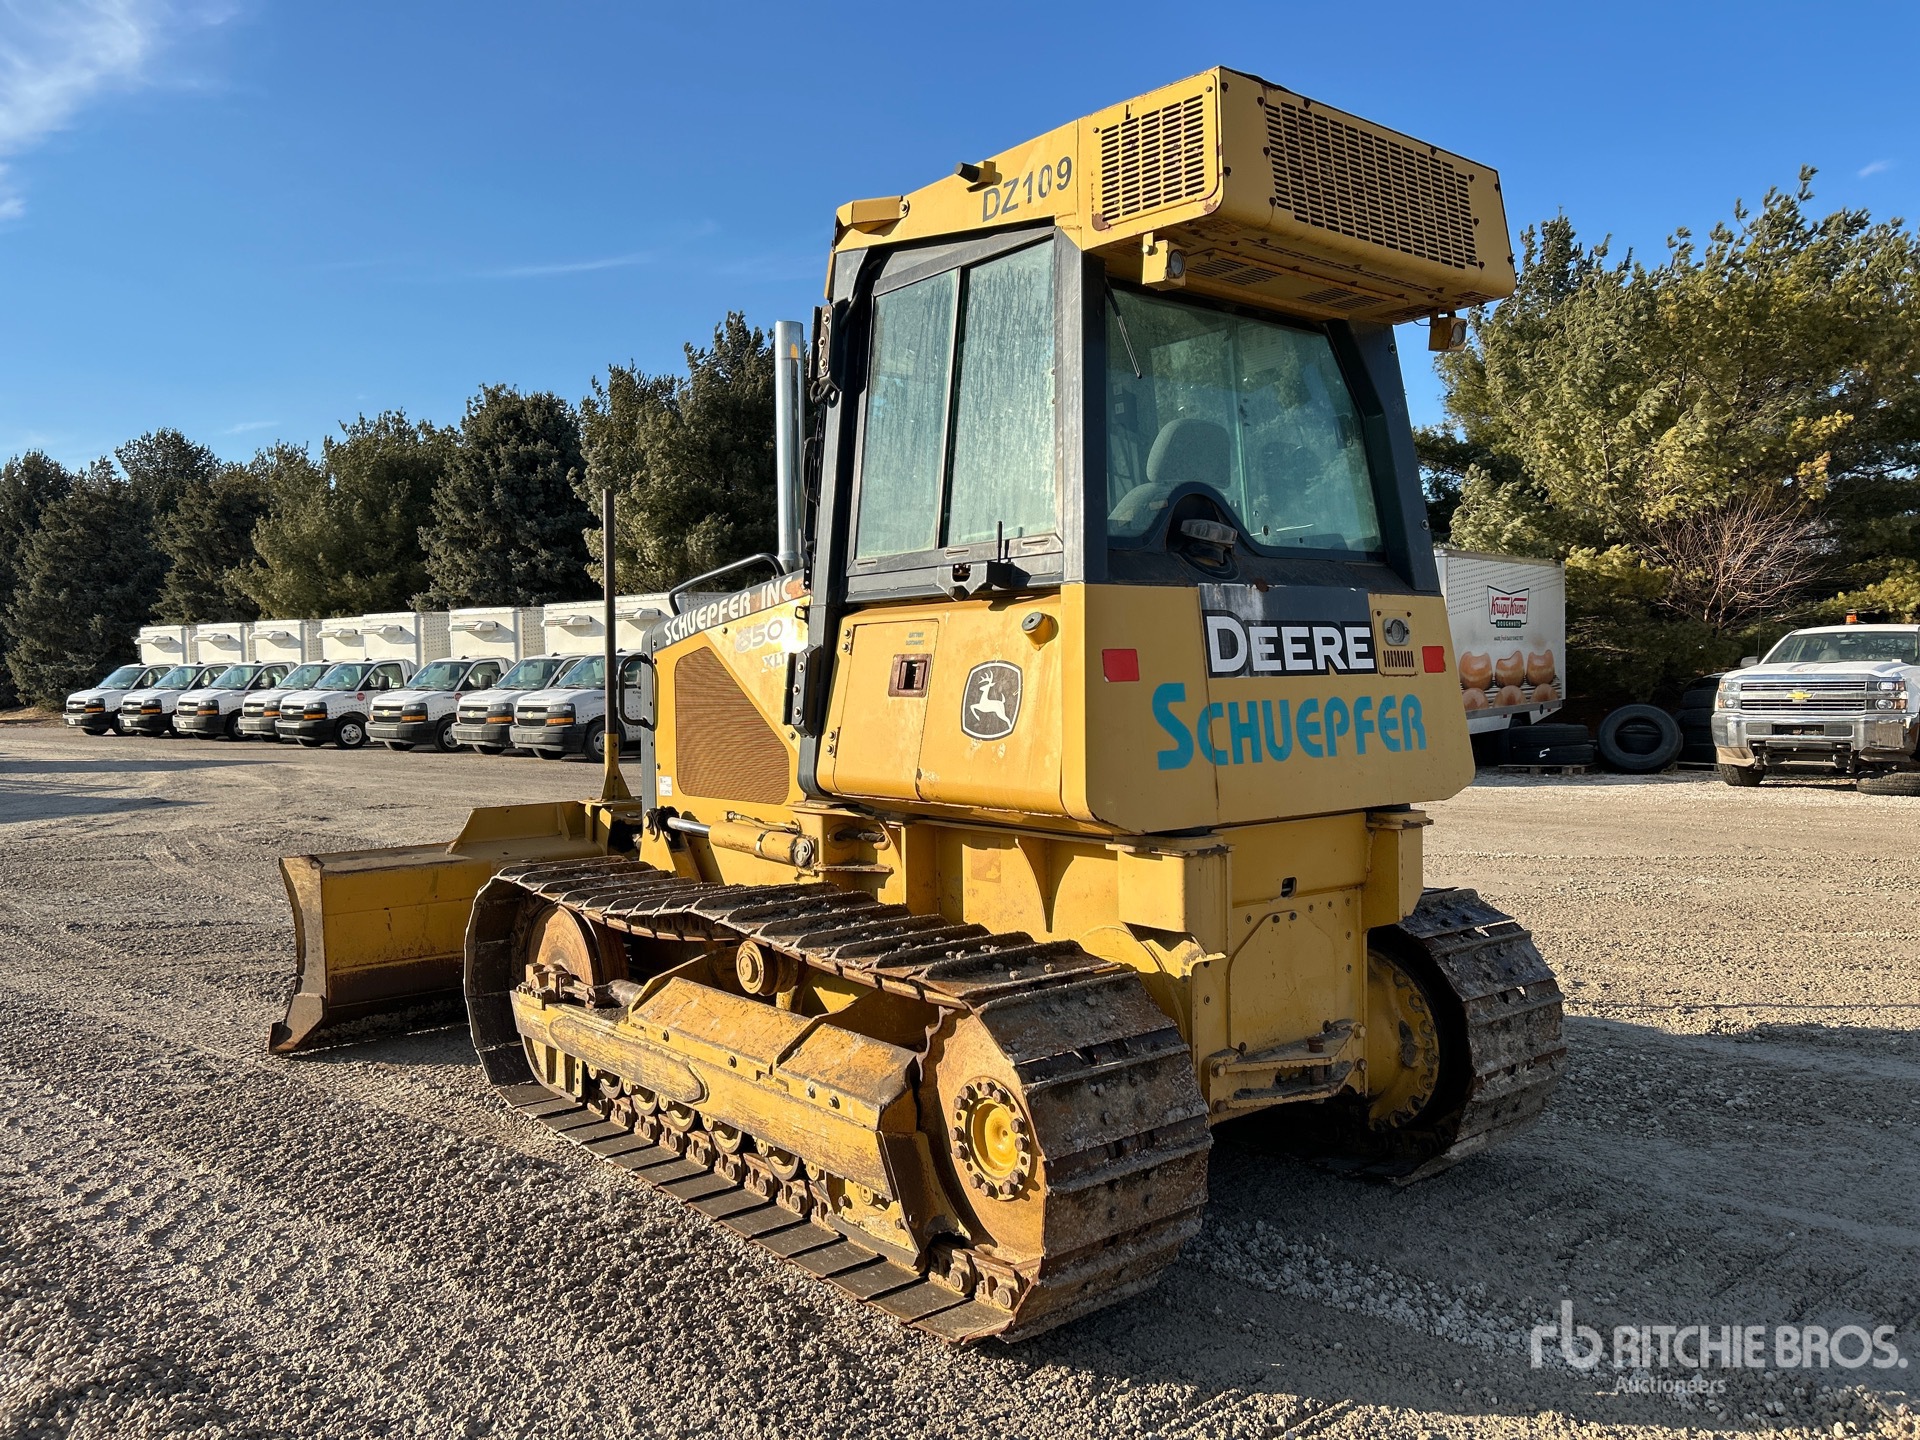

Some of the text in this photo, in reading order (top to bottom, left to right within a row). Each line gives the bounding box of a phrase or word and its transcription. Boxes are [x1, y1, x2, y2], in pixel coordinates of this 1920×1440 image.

[983, 156, 1072, 222] DZ109
[664, 576, 793, 646] SCHUEPFER INC
[1491, 596, 1527, 618] Krispy Kreme
[763, 652, 786, 669] XLT
[1206, 615, 1375, 673] DEERE
[1152, 683, 1428, 771] SCHUEPFER
